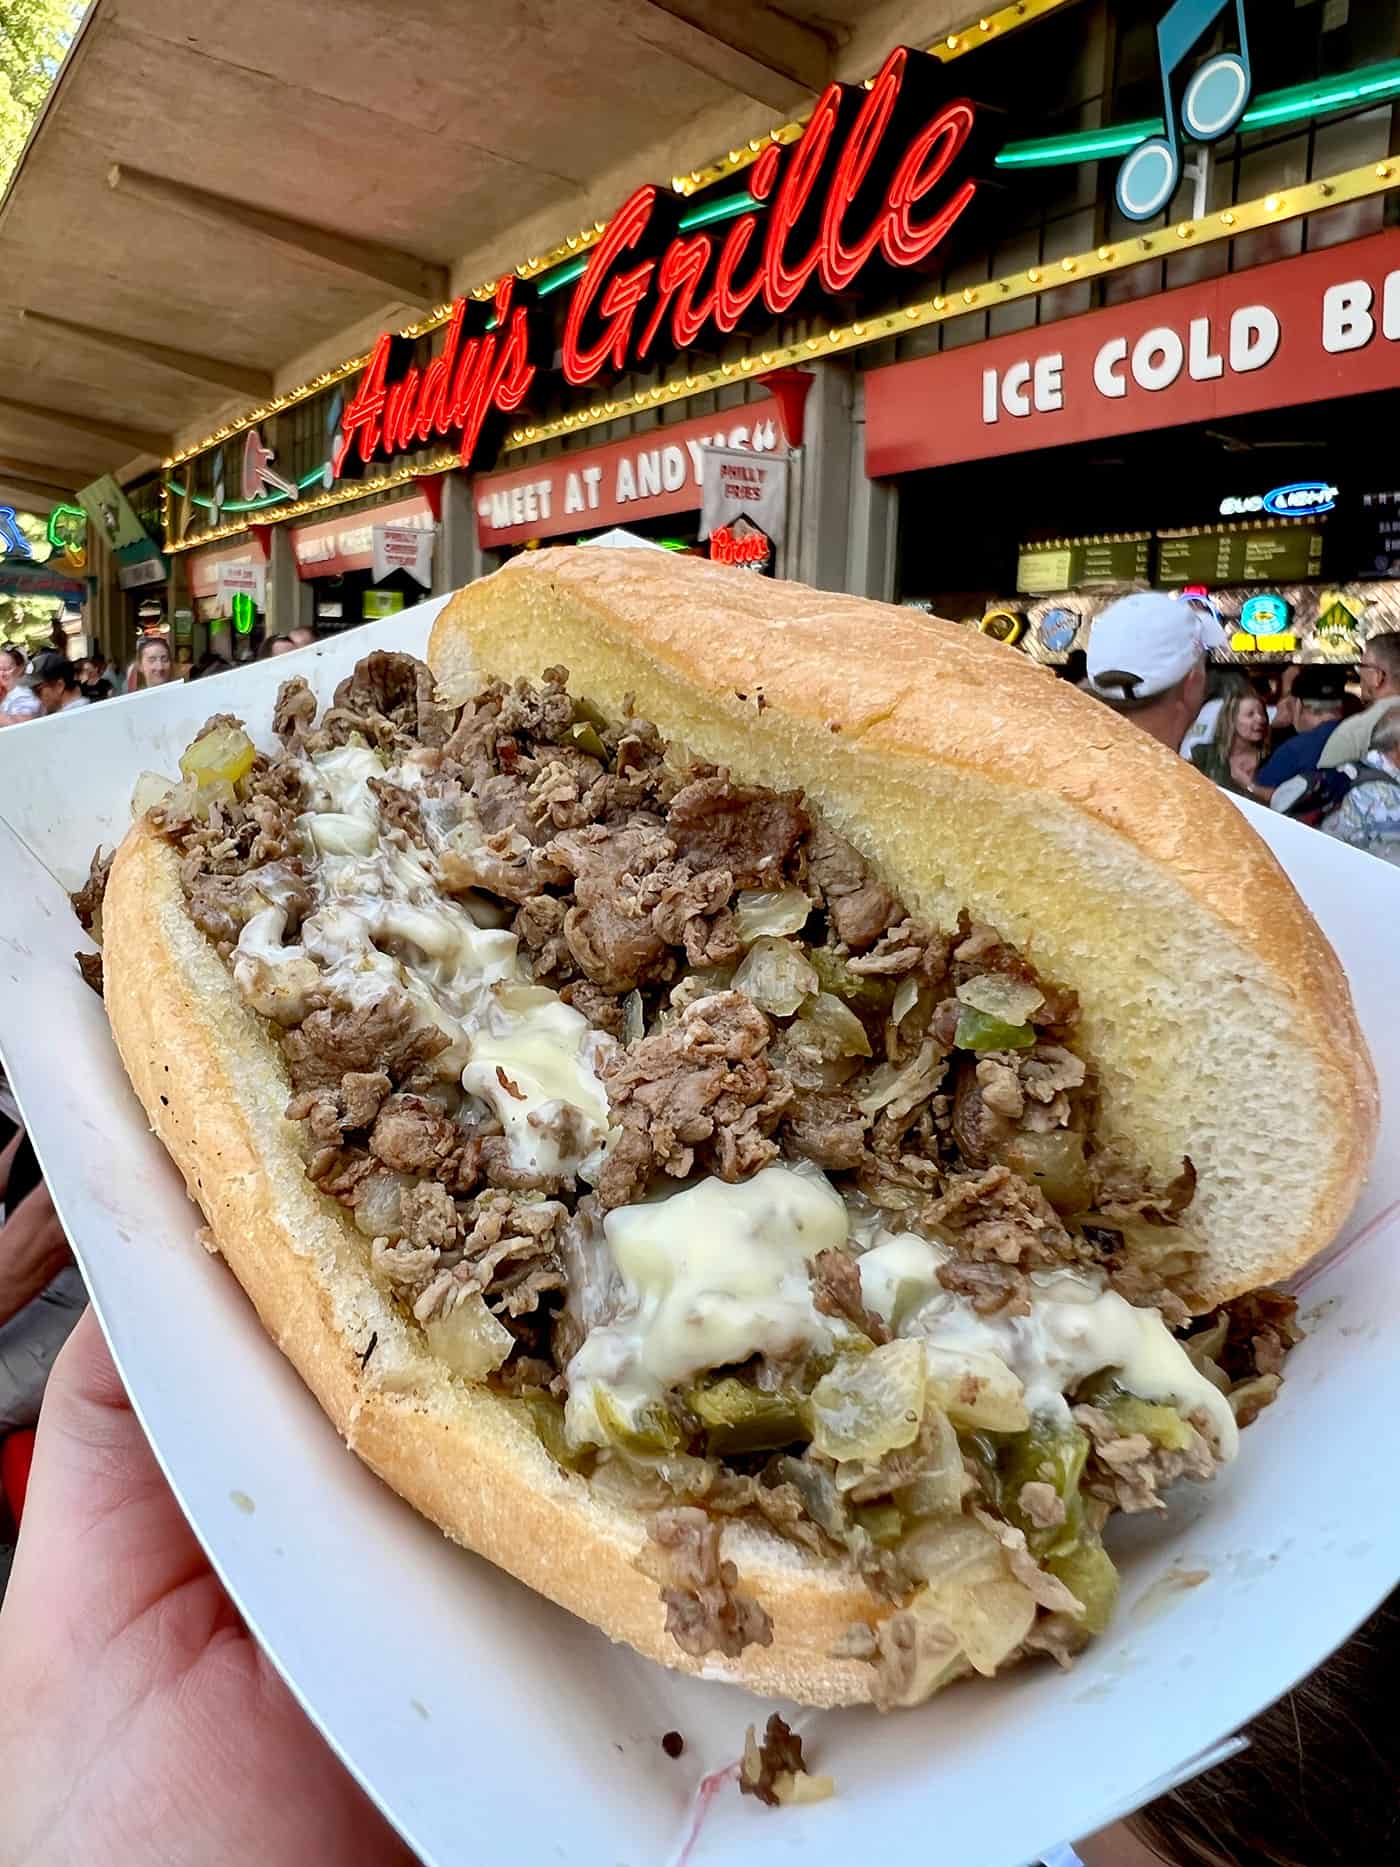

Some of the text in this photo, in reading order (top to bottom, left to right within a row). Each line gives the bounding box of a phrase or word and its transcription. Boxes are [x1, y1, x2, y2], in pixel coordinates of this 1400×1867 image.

[333, 45, 977, 479] Andy's Grille
[982, 352, 1063, 424] ICE
[1093, 304, 1280, 398] COLD
[564, 466, 602, 515] AT
[724, 482, 762, 501] FRIES
